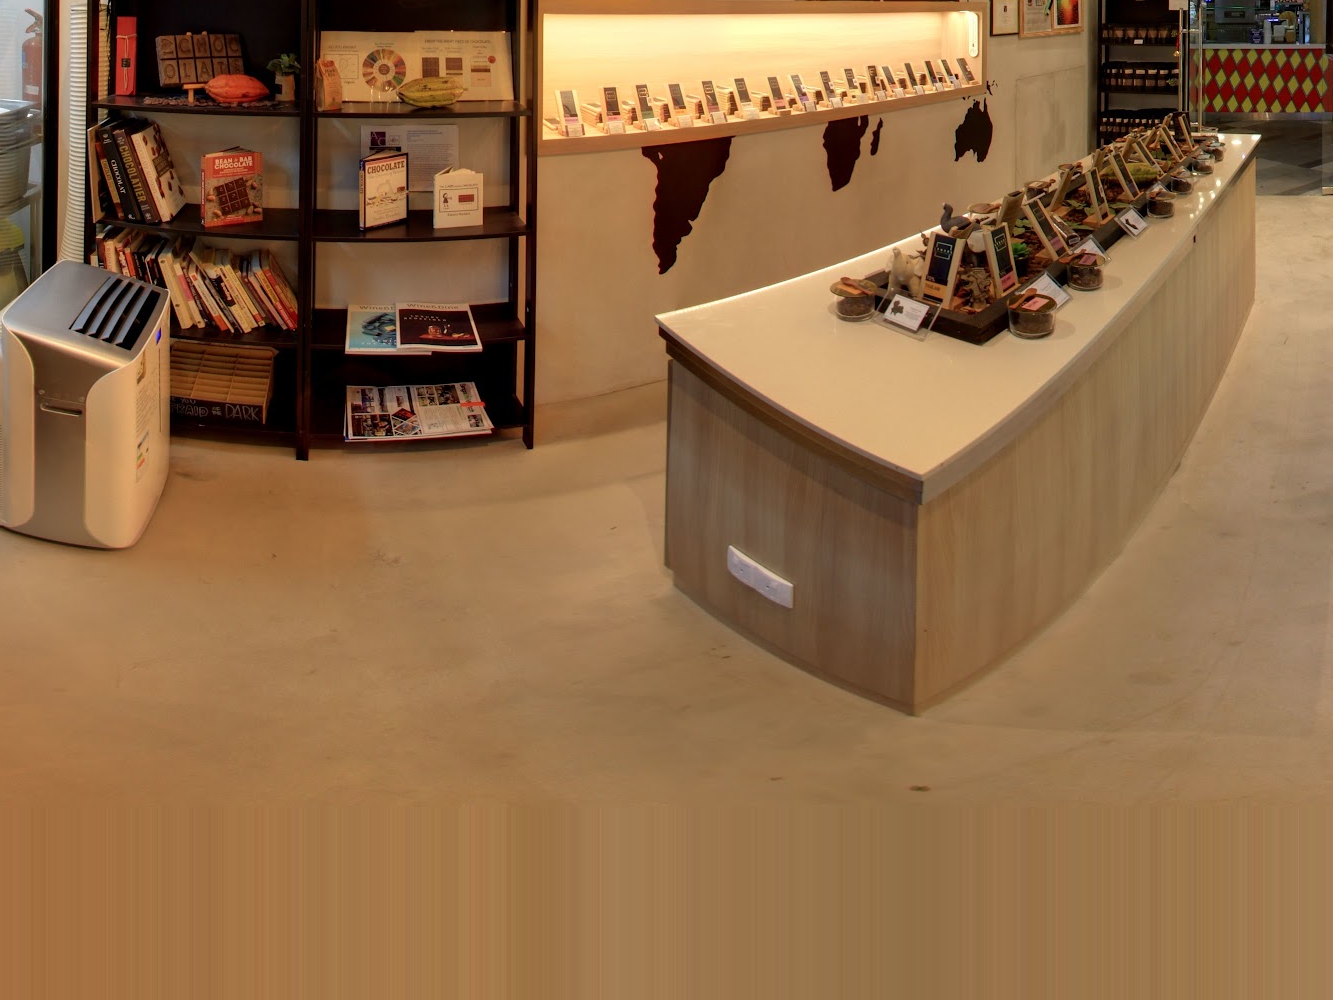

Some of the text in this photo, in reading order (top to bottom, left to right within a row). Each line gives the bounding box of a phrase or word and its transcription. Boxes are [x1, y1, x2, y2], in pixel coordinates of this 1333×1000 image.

[214, 161, 253, 170] CHOCOLATE
[215, 158, 233, 166] BEAN
[367, 160, 405, 175] CHOCOLATE
[110, 159, 126, 194] CHOCOLAT
[118, 145, 147, 203] CHOCOLATIER
[225, 403, 259, 421] DARK
